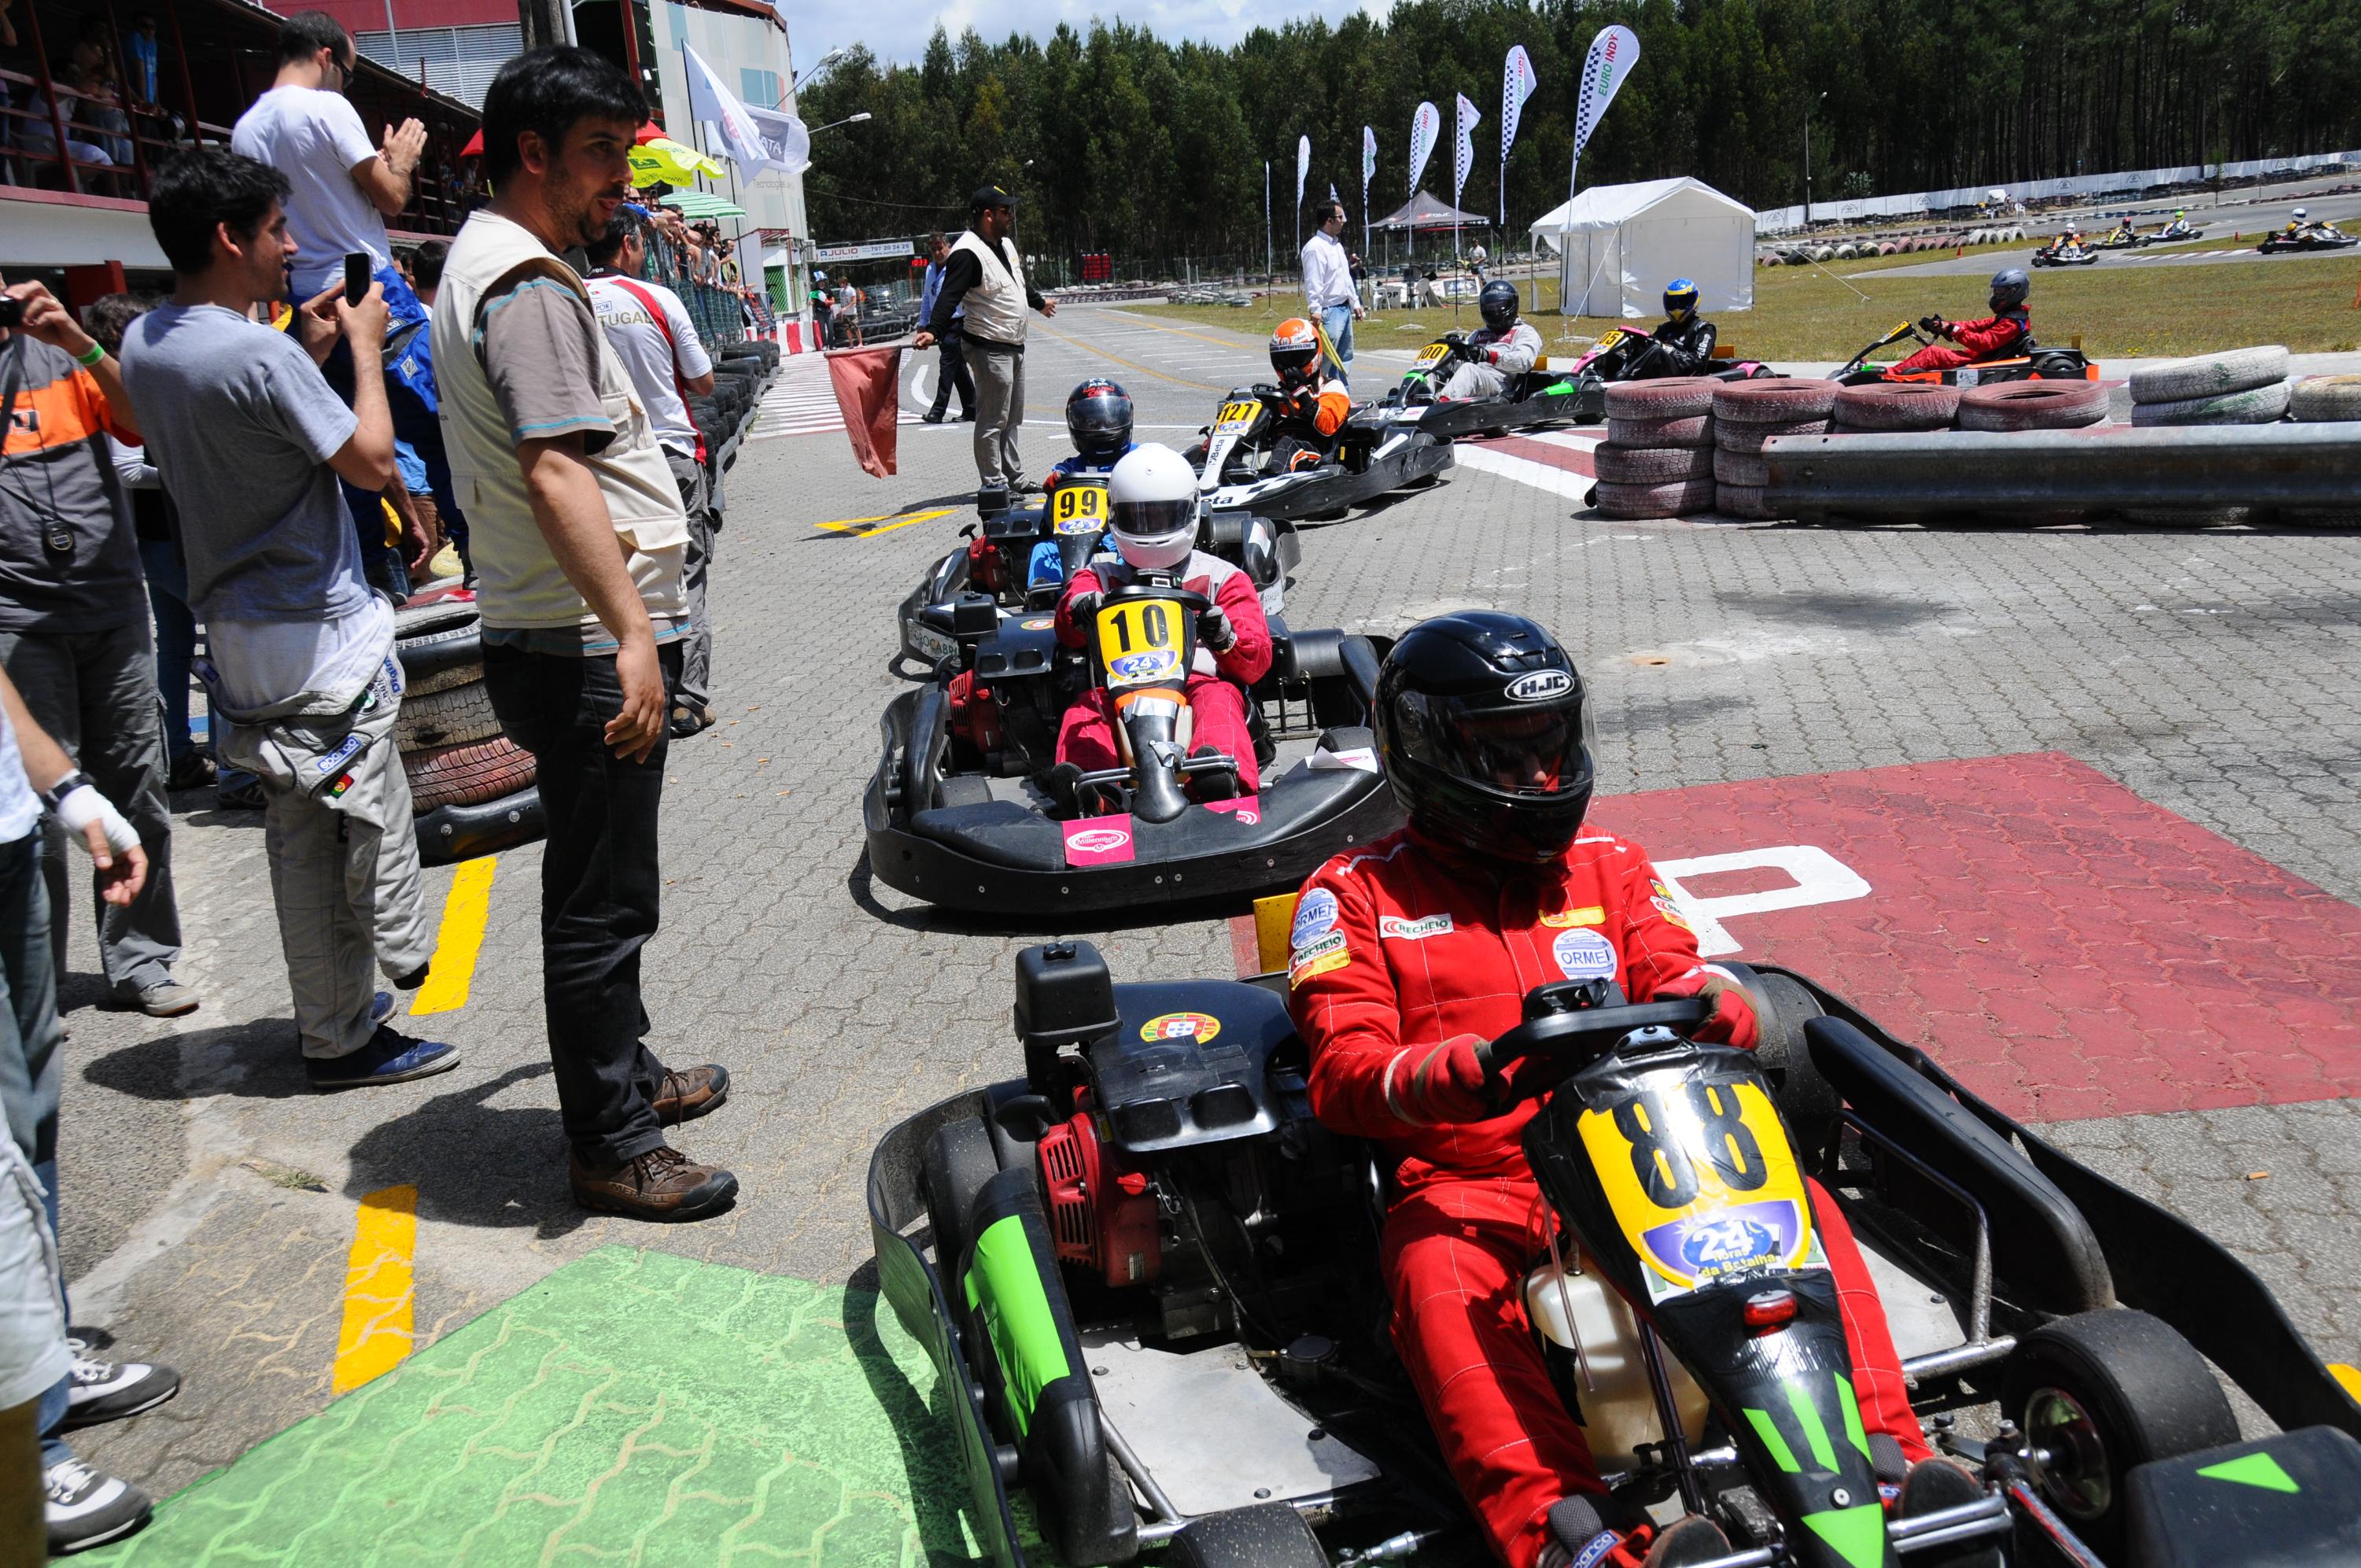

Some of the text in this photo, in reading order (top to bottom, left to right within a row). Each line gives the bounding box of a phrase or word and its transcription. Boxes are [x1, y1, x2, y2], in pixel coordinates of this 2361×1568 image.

[1598, 33, 1618, 97] EURO INDY
[598, 311, 653, 327] TUGAL
[1599, 332, 1619, 348] 05
[1418, 346, 1444, 360] 100
[1221, 404, 1254, 422] 127
[1060, 489, 1097, 518] 99
[1110, 604, 1169, 653] 10
[1128, 656, 1153, 673] 24
[1520, 676, 1566, 696] HJC
[1399, 920, 1448, 934] RECHEIO
[1297, 936, 1341, 962] RECHEIO
[1613, 1080, 1769, 1209] 88
[1693, 1221, 1754, 1262] 24
[1701, 1267, 1720, 1278] da
[1573, 1533, 1614, 1568] parco
